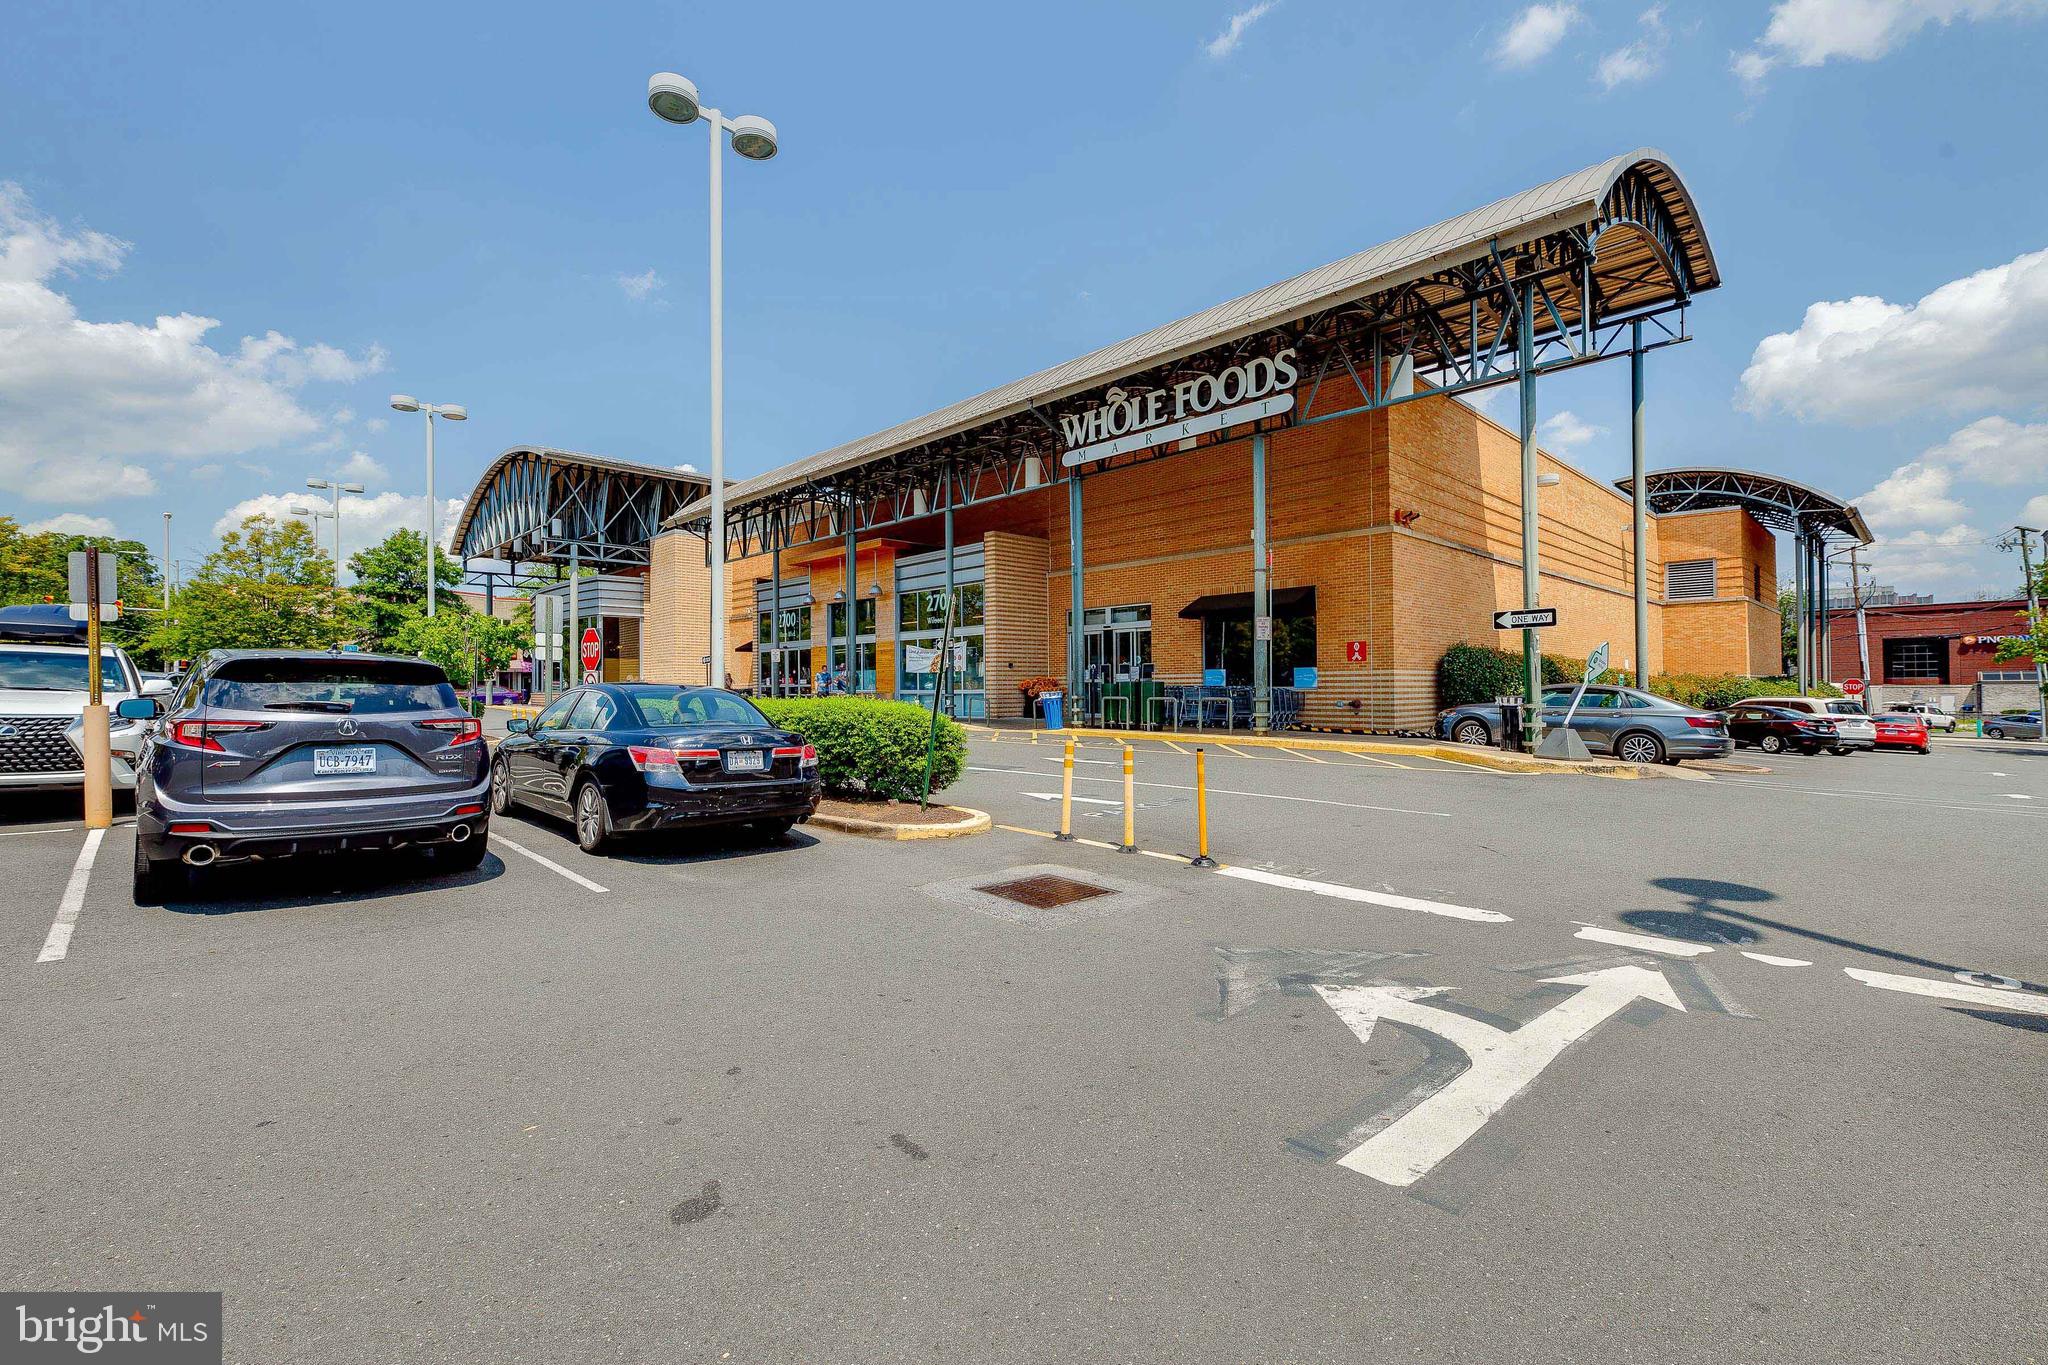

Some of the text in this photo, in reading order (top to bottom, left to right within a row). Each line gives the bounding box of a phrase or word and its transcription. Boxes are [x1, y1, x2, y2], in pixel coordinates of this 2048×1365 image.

[1059, 348, 1298, 448] WHOLE FOODS
[1078, 401, 1270, 462] MARKET
[1511, 613, 1550, 624] ONE WAY
[582, 641, 599, 659] STOP
[319, 754, 373, 768] UCB-7947
